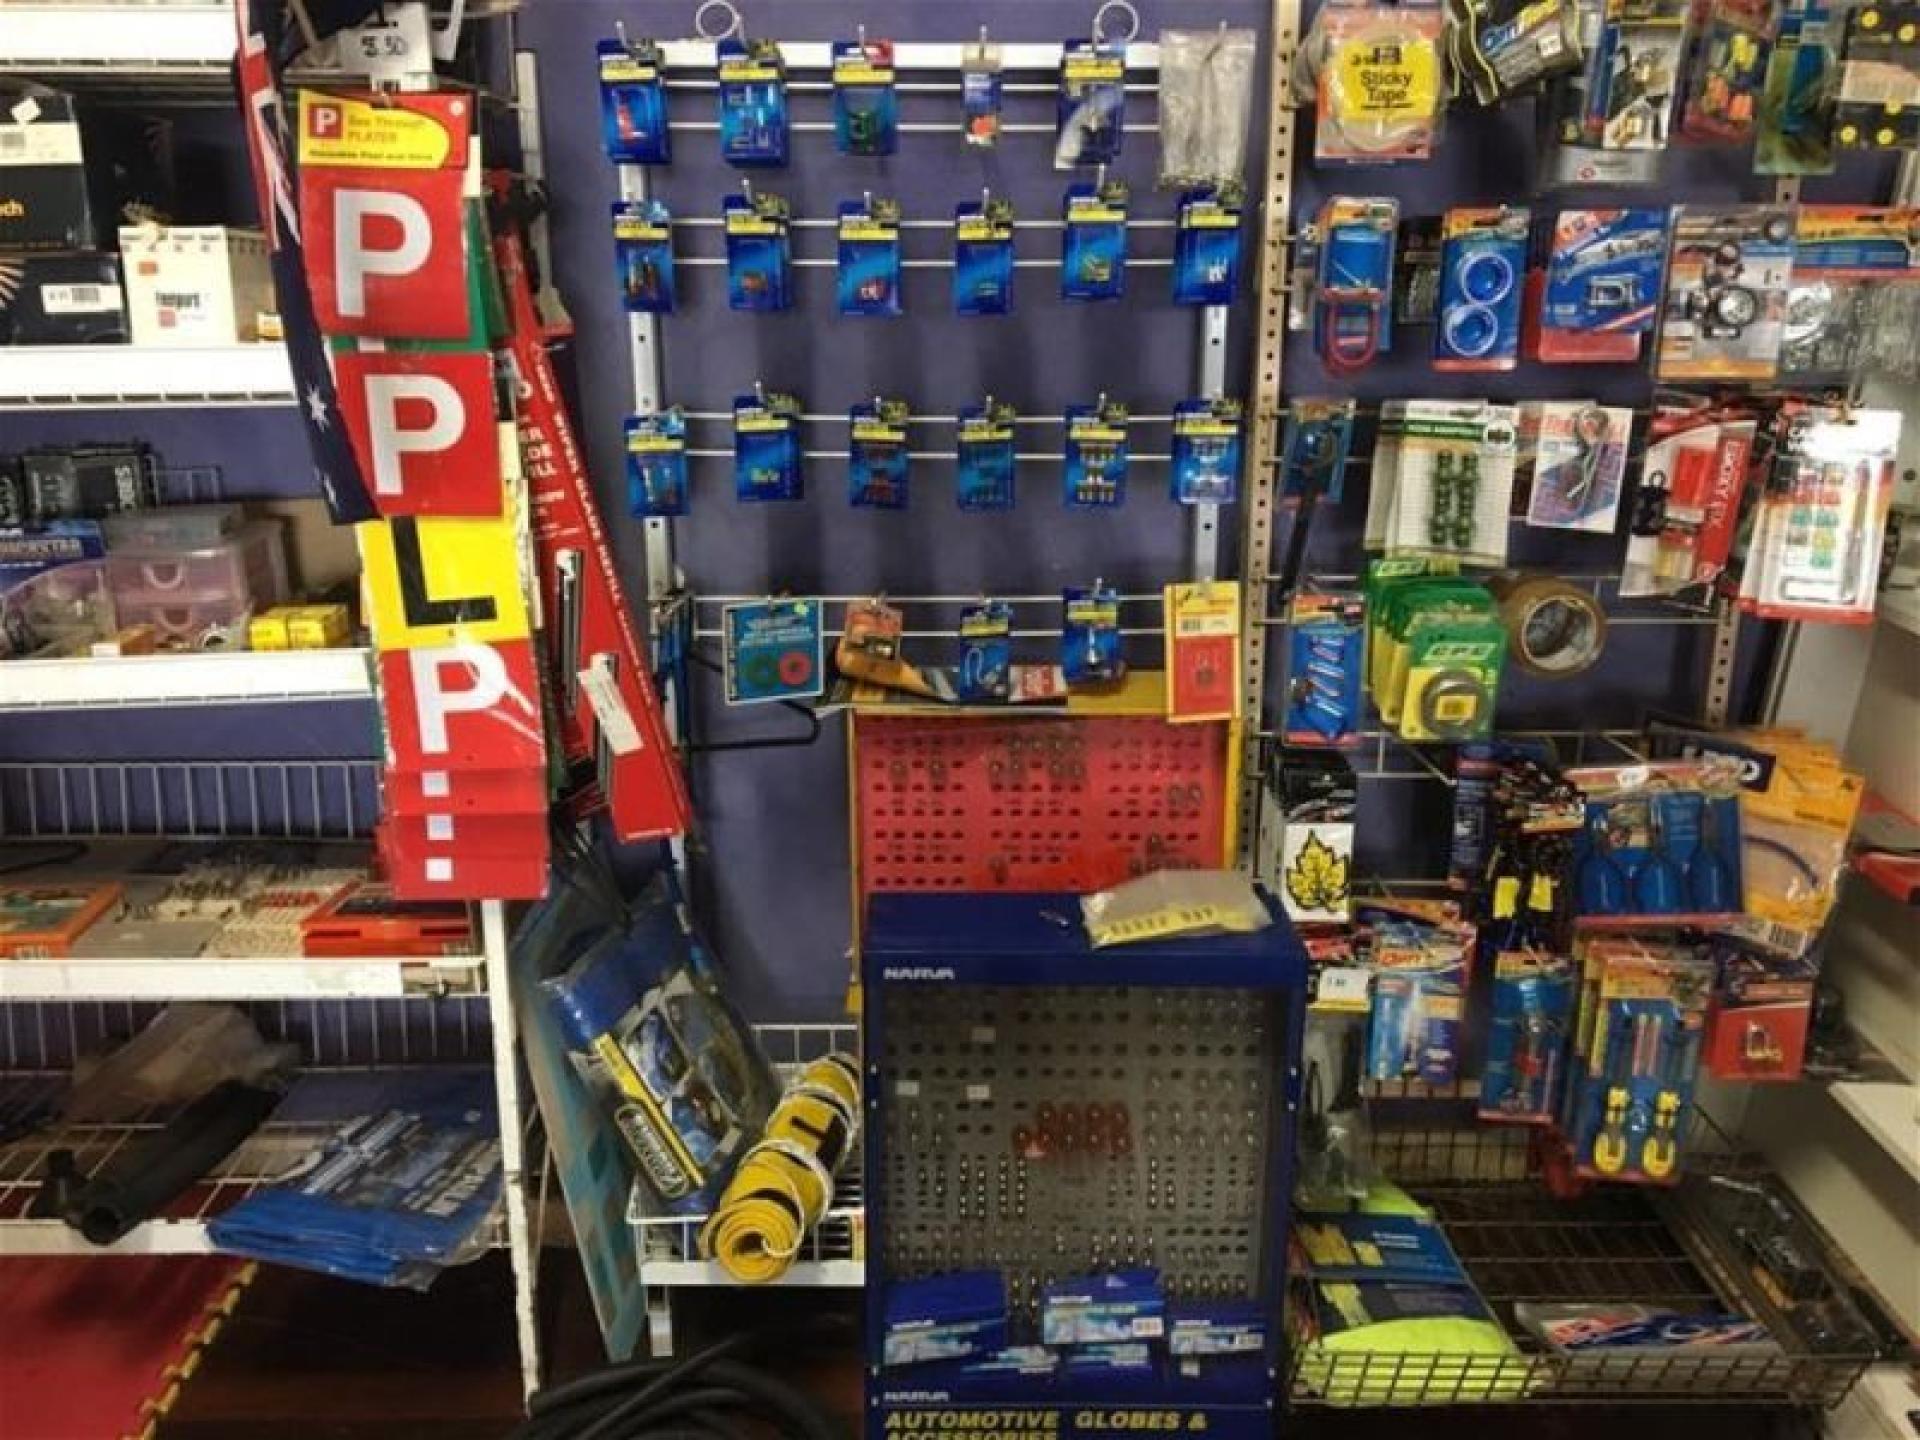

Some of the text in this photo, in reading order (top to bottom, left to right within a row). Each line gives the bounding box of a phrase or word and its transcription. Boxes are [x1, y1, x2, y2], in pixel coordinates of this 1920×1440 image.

[1360, 71, 1413, 87] Sticky
[1368, 88, 1406, 108] Tape
[317, 108, 336, 133] P
[334, 190, 432, 316] P
[364, 374, 466, 495] P
[392, 516, 497, 627] L
[410, 641, 508, 754] P
[885, 1410, 1058, 1429] AUTOMOTIVE
[1074, 1410, 1181, 1429] GLOBES
